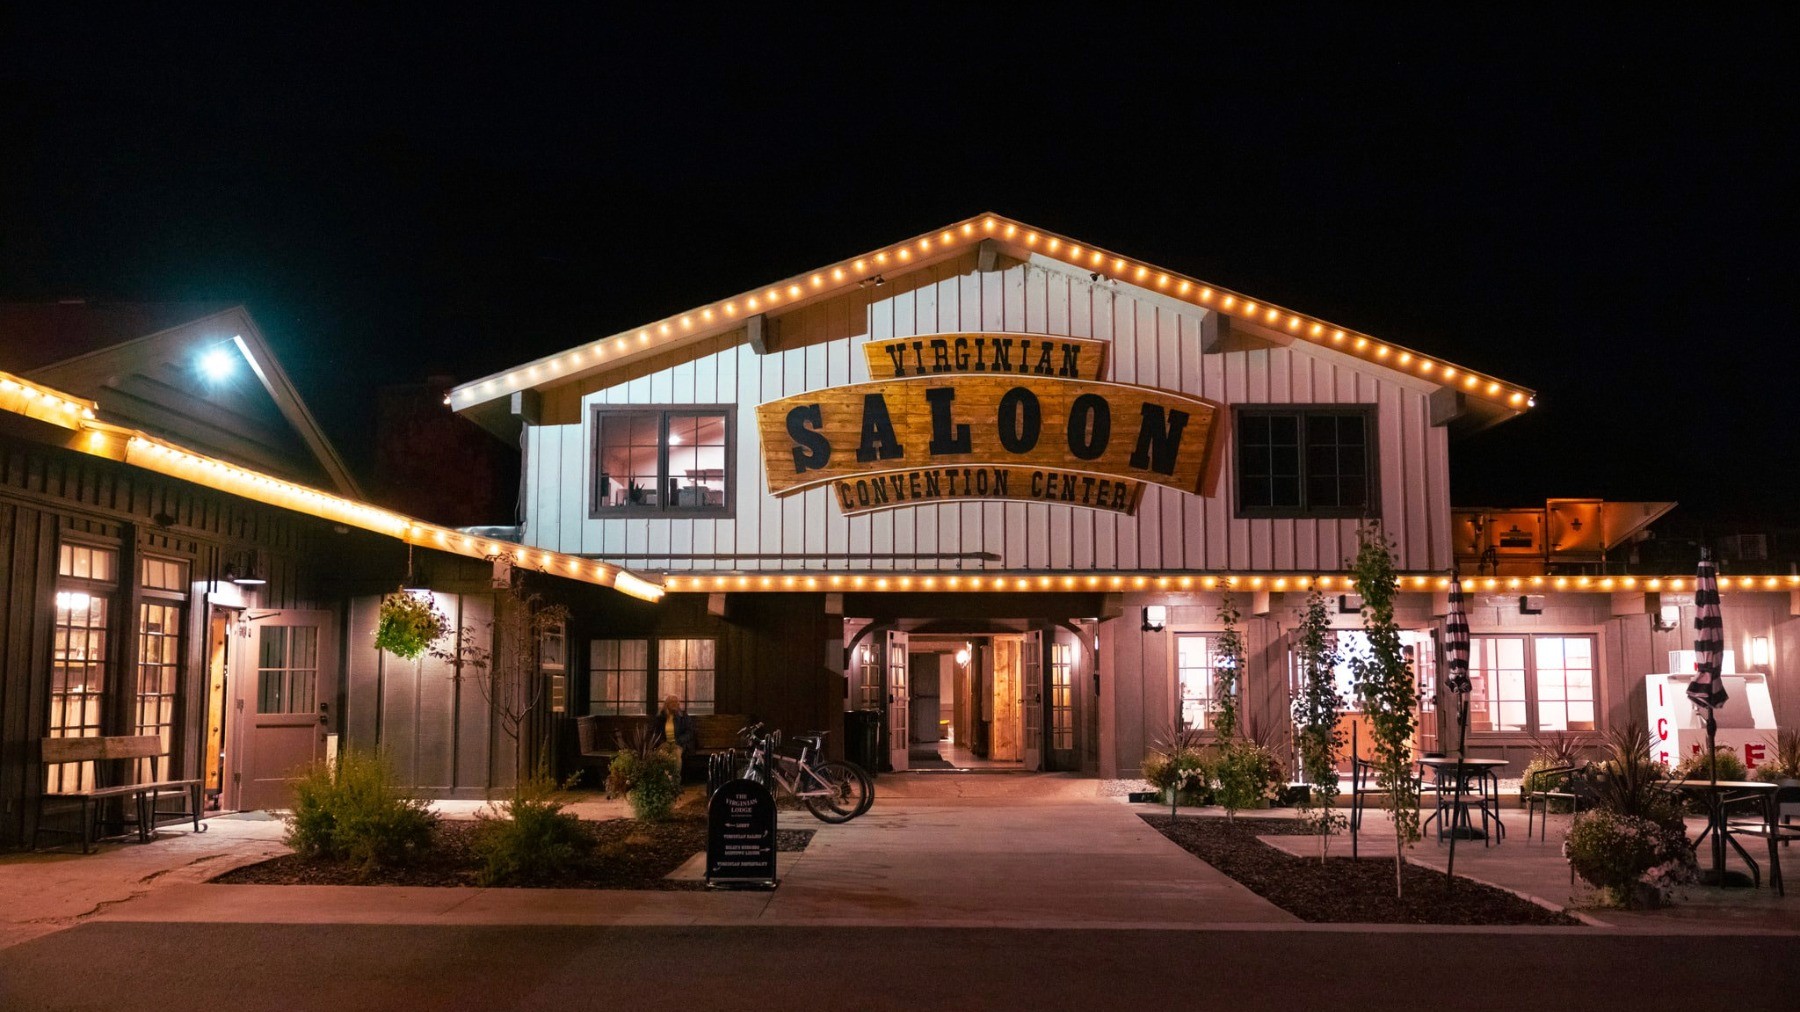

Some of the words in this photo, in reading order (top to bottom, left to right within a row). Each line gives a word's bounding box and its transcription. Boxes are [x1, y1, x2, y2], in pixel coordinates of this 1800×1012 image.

[885, 338, 1081, 378] VIRGINIAN
[785, 386, 1189, 476] SALOON
[841, 468, 1008, 510] CONVENTION
[1031, 470, 1127, 510] CENTER
[725, 798, 758, 806] VIRGINIAN
